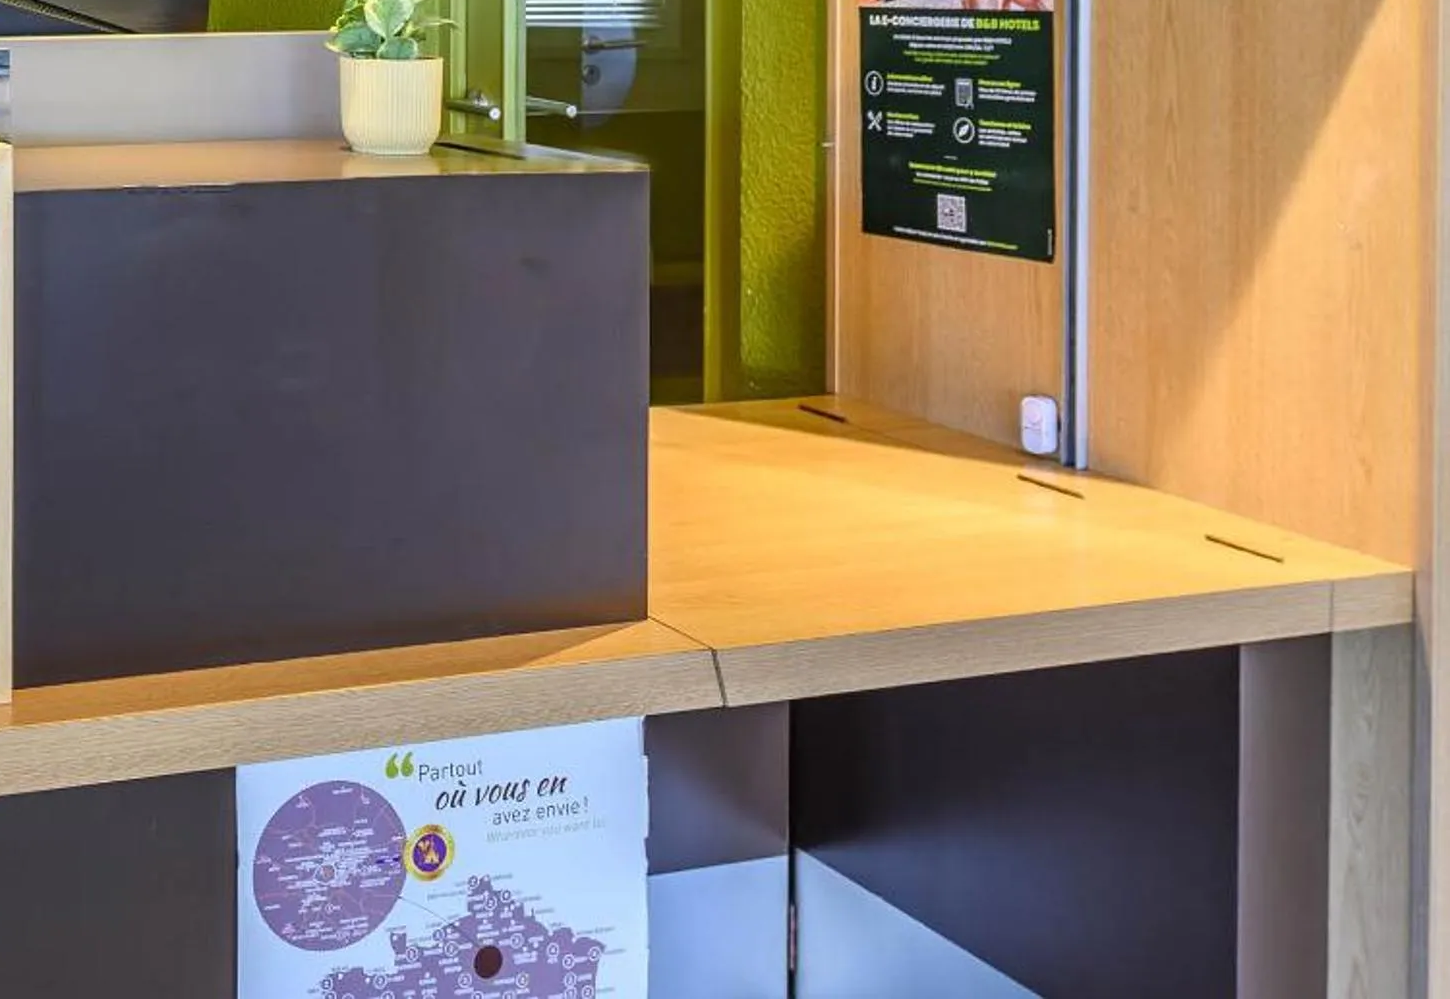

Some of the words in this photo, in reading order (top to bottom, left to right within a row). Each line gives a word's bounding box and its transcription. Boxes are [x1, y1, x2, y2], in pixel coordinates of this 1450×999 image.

[999, 19, 1041, 32] HOTELS
[418, 759, 483, 782] Partout
[435, 779, 468, 811] où
[475, 776, 531, 807] vous
[536, 774, 568, 797] en
[492, 806, 531, 826] avez
